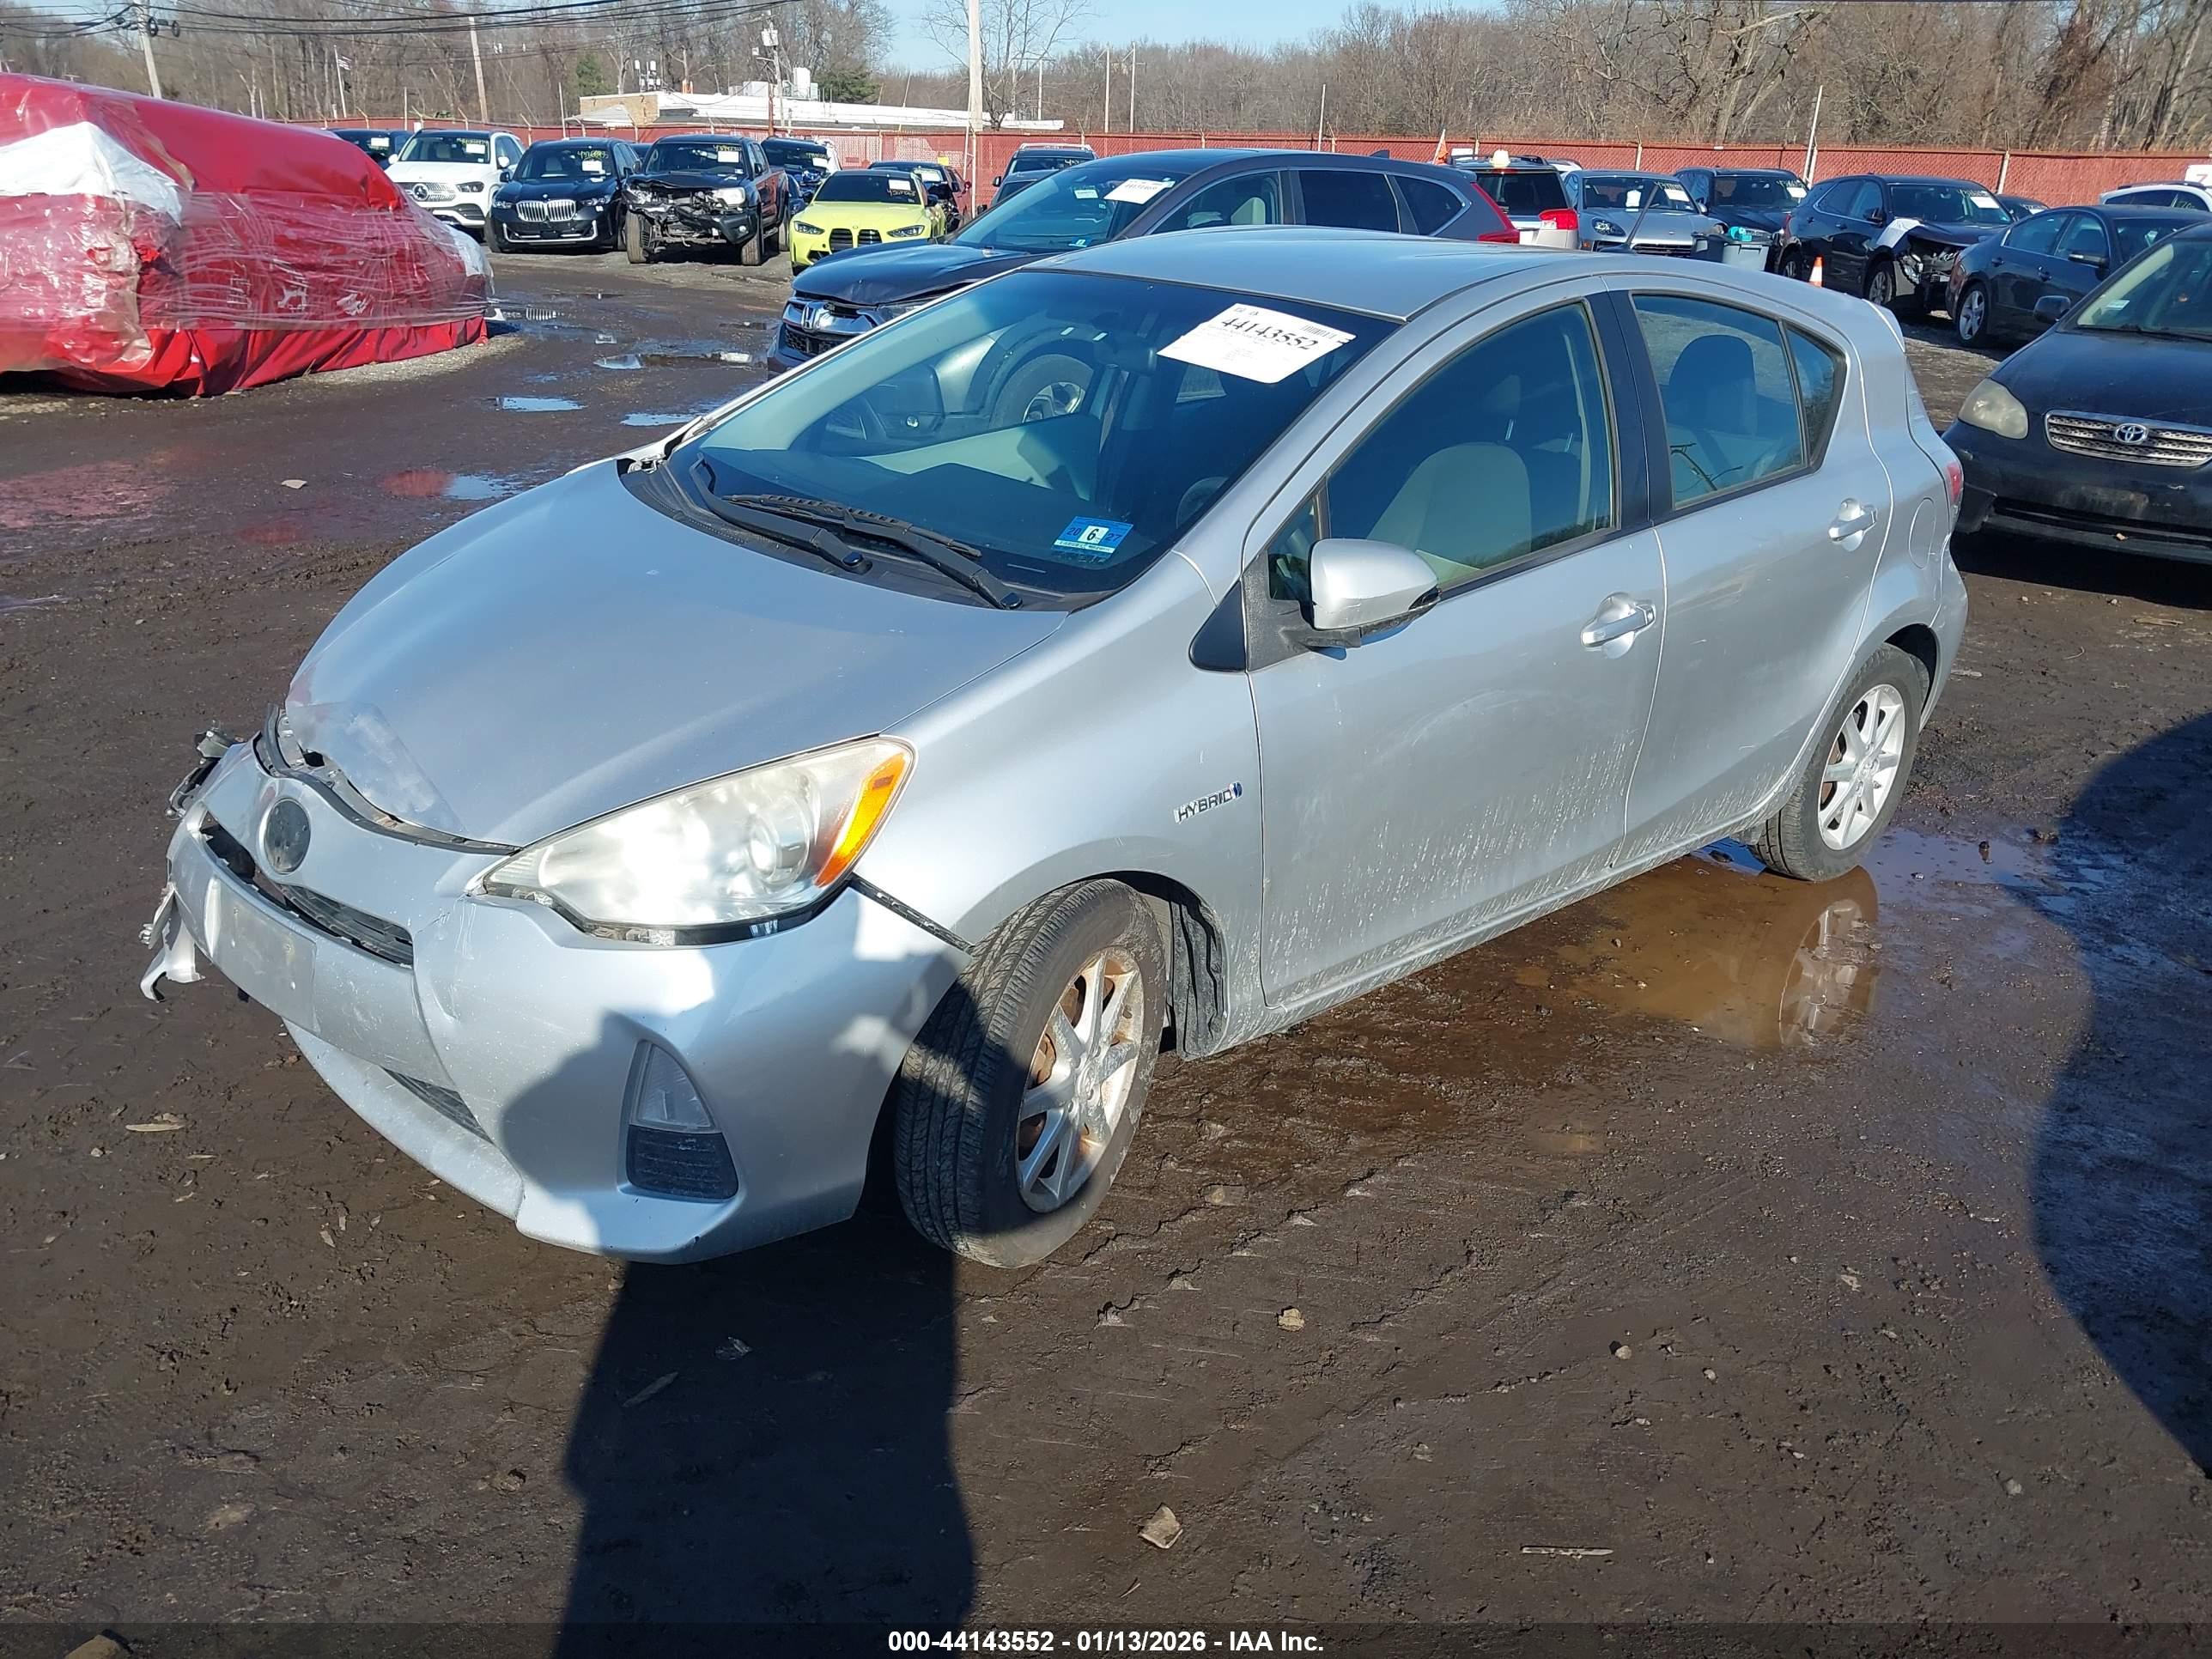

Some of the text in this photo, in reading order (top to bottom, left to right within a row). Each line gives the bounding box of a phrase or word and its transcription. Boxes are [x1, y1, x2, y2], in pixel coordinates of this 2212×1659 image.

[1220, 317, 1320, 350] 44143552
[1066, 527, 1082, 537] 20
[1086, 528, 1099, 541] 6
[1176, 789, 1233, 822] HYBRID
